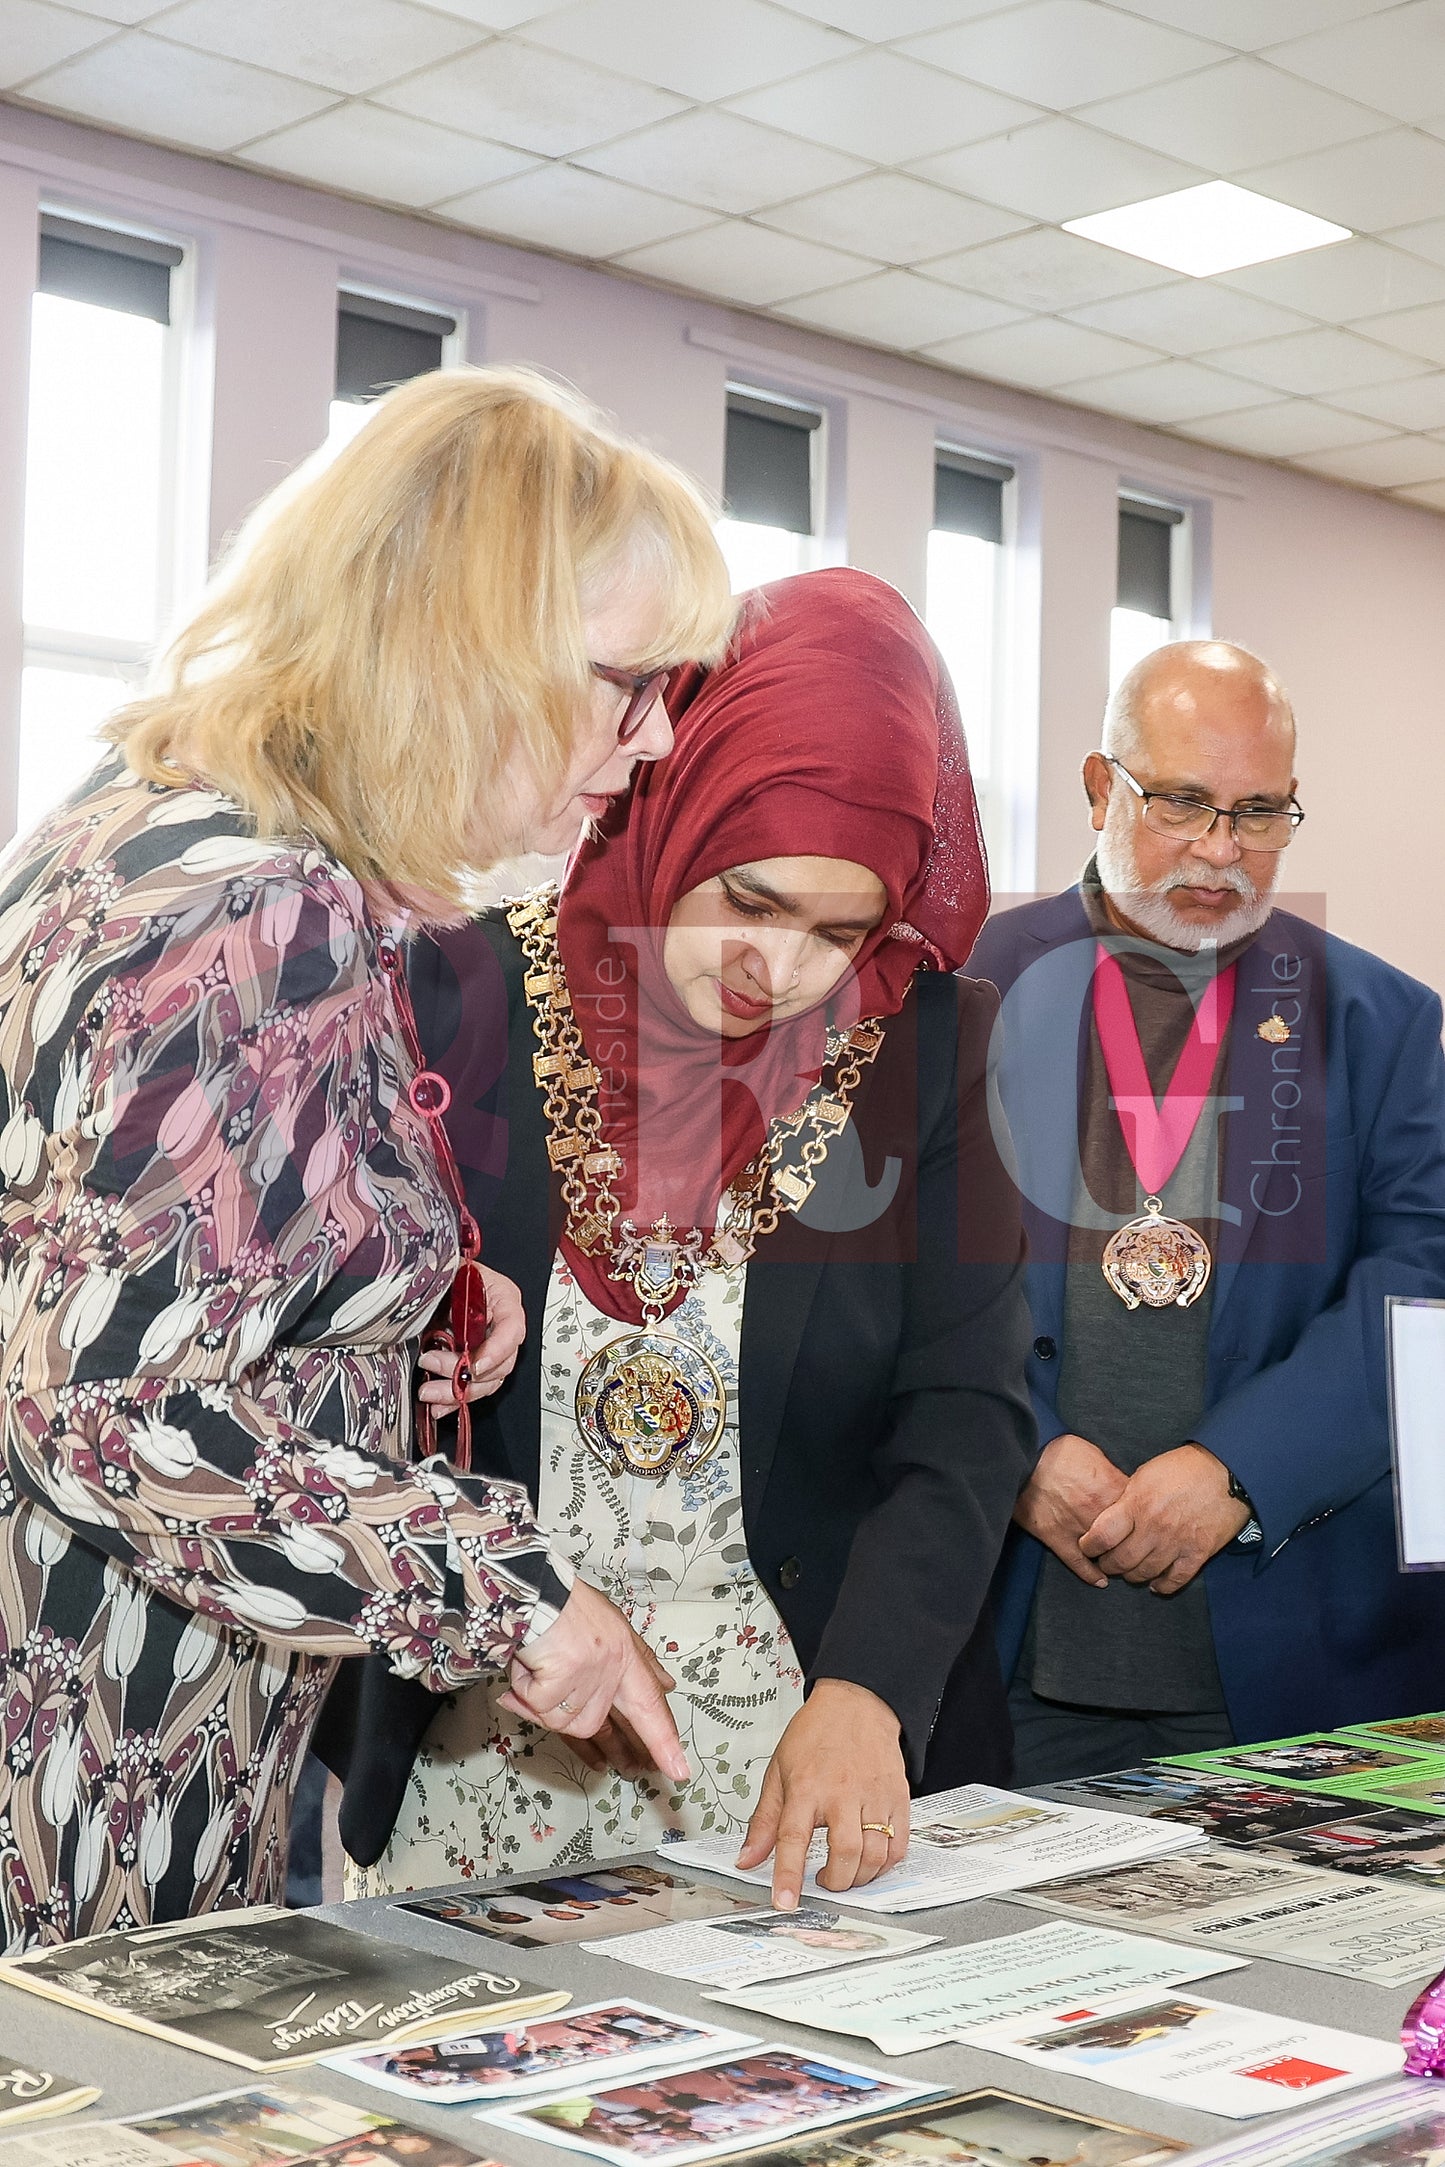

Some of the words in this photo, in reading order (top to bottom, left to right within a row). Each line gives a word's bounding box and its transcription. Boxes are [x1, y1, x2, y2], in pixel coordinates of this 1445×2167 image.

[1099, 1822, 1133, 1835] fund
[1193, 1918, 1258, 1934] WITNESS
[983, 1965, 1132, 2004] MOTORWAY
[1076, 1969, 1186, 1996] DENTON
[378, 1972, 520, 2028] Redemption
[894, 2003, 980, 2024] WALK
[921, 1996, 1078, 2035] REPORTER
[271, 2001, 385, 2051] Tidings
[1172, 2040, 1234, 2060] CENTRE
[1241, 2036, 1307, 2055] CARMEL
[1160, 2056, 1245, 2080] CHRISTIAN
[1233, 2056, 1292, 2074] CARMEL
